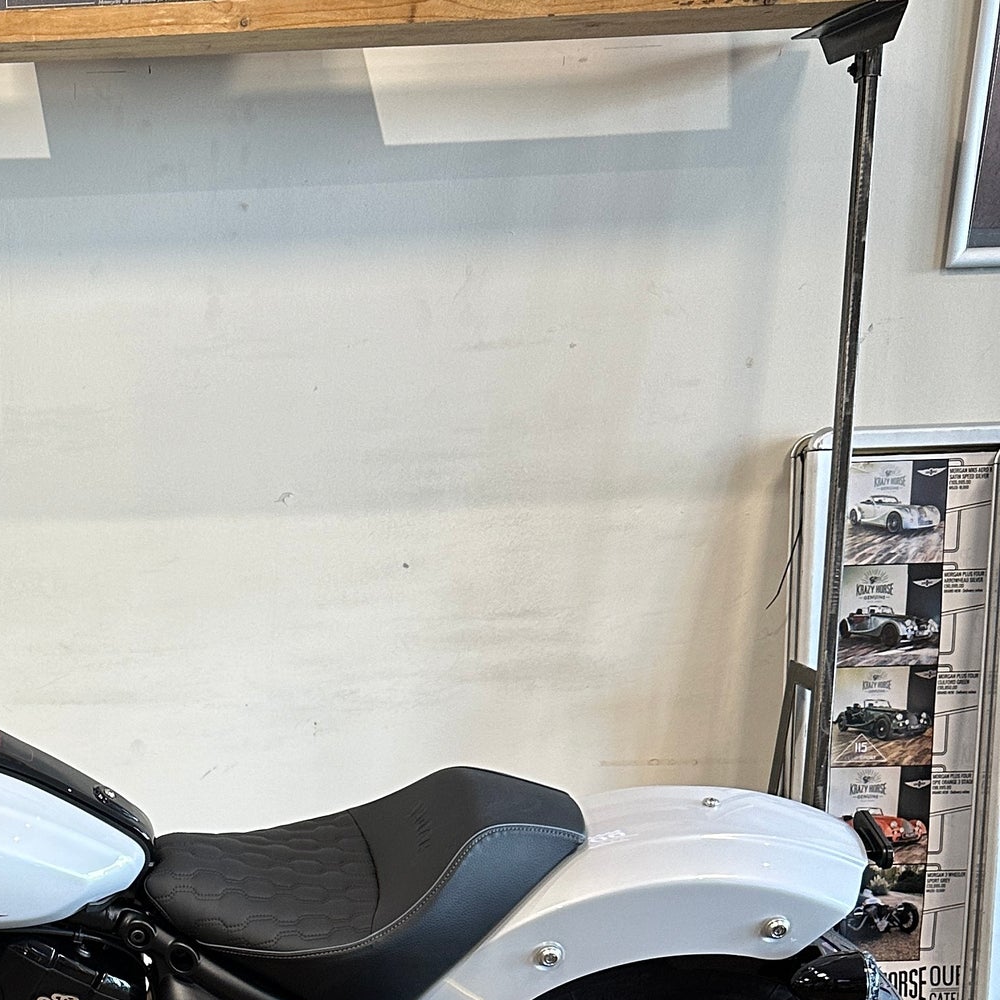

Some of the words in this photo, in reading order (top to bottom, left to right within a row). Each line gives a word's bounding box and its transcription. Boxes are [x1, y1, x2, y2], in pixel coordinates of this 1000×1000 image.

[856, 584, 875, 596] KRAZY
[876, 583, 894, 595] HORSE
[863, 681, 877, 690] KRAZY
[877, 680, 891, 690] HORSE
[855, 742, 867, 753] 115
[850, 783, 868, 795] KRAZY
[868, 782, 887, 795] HORSE
